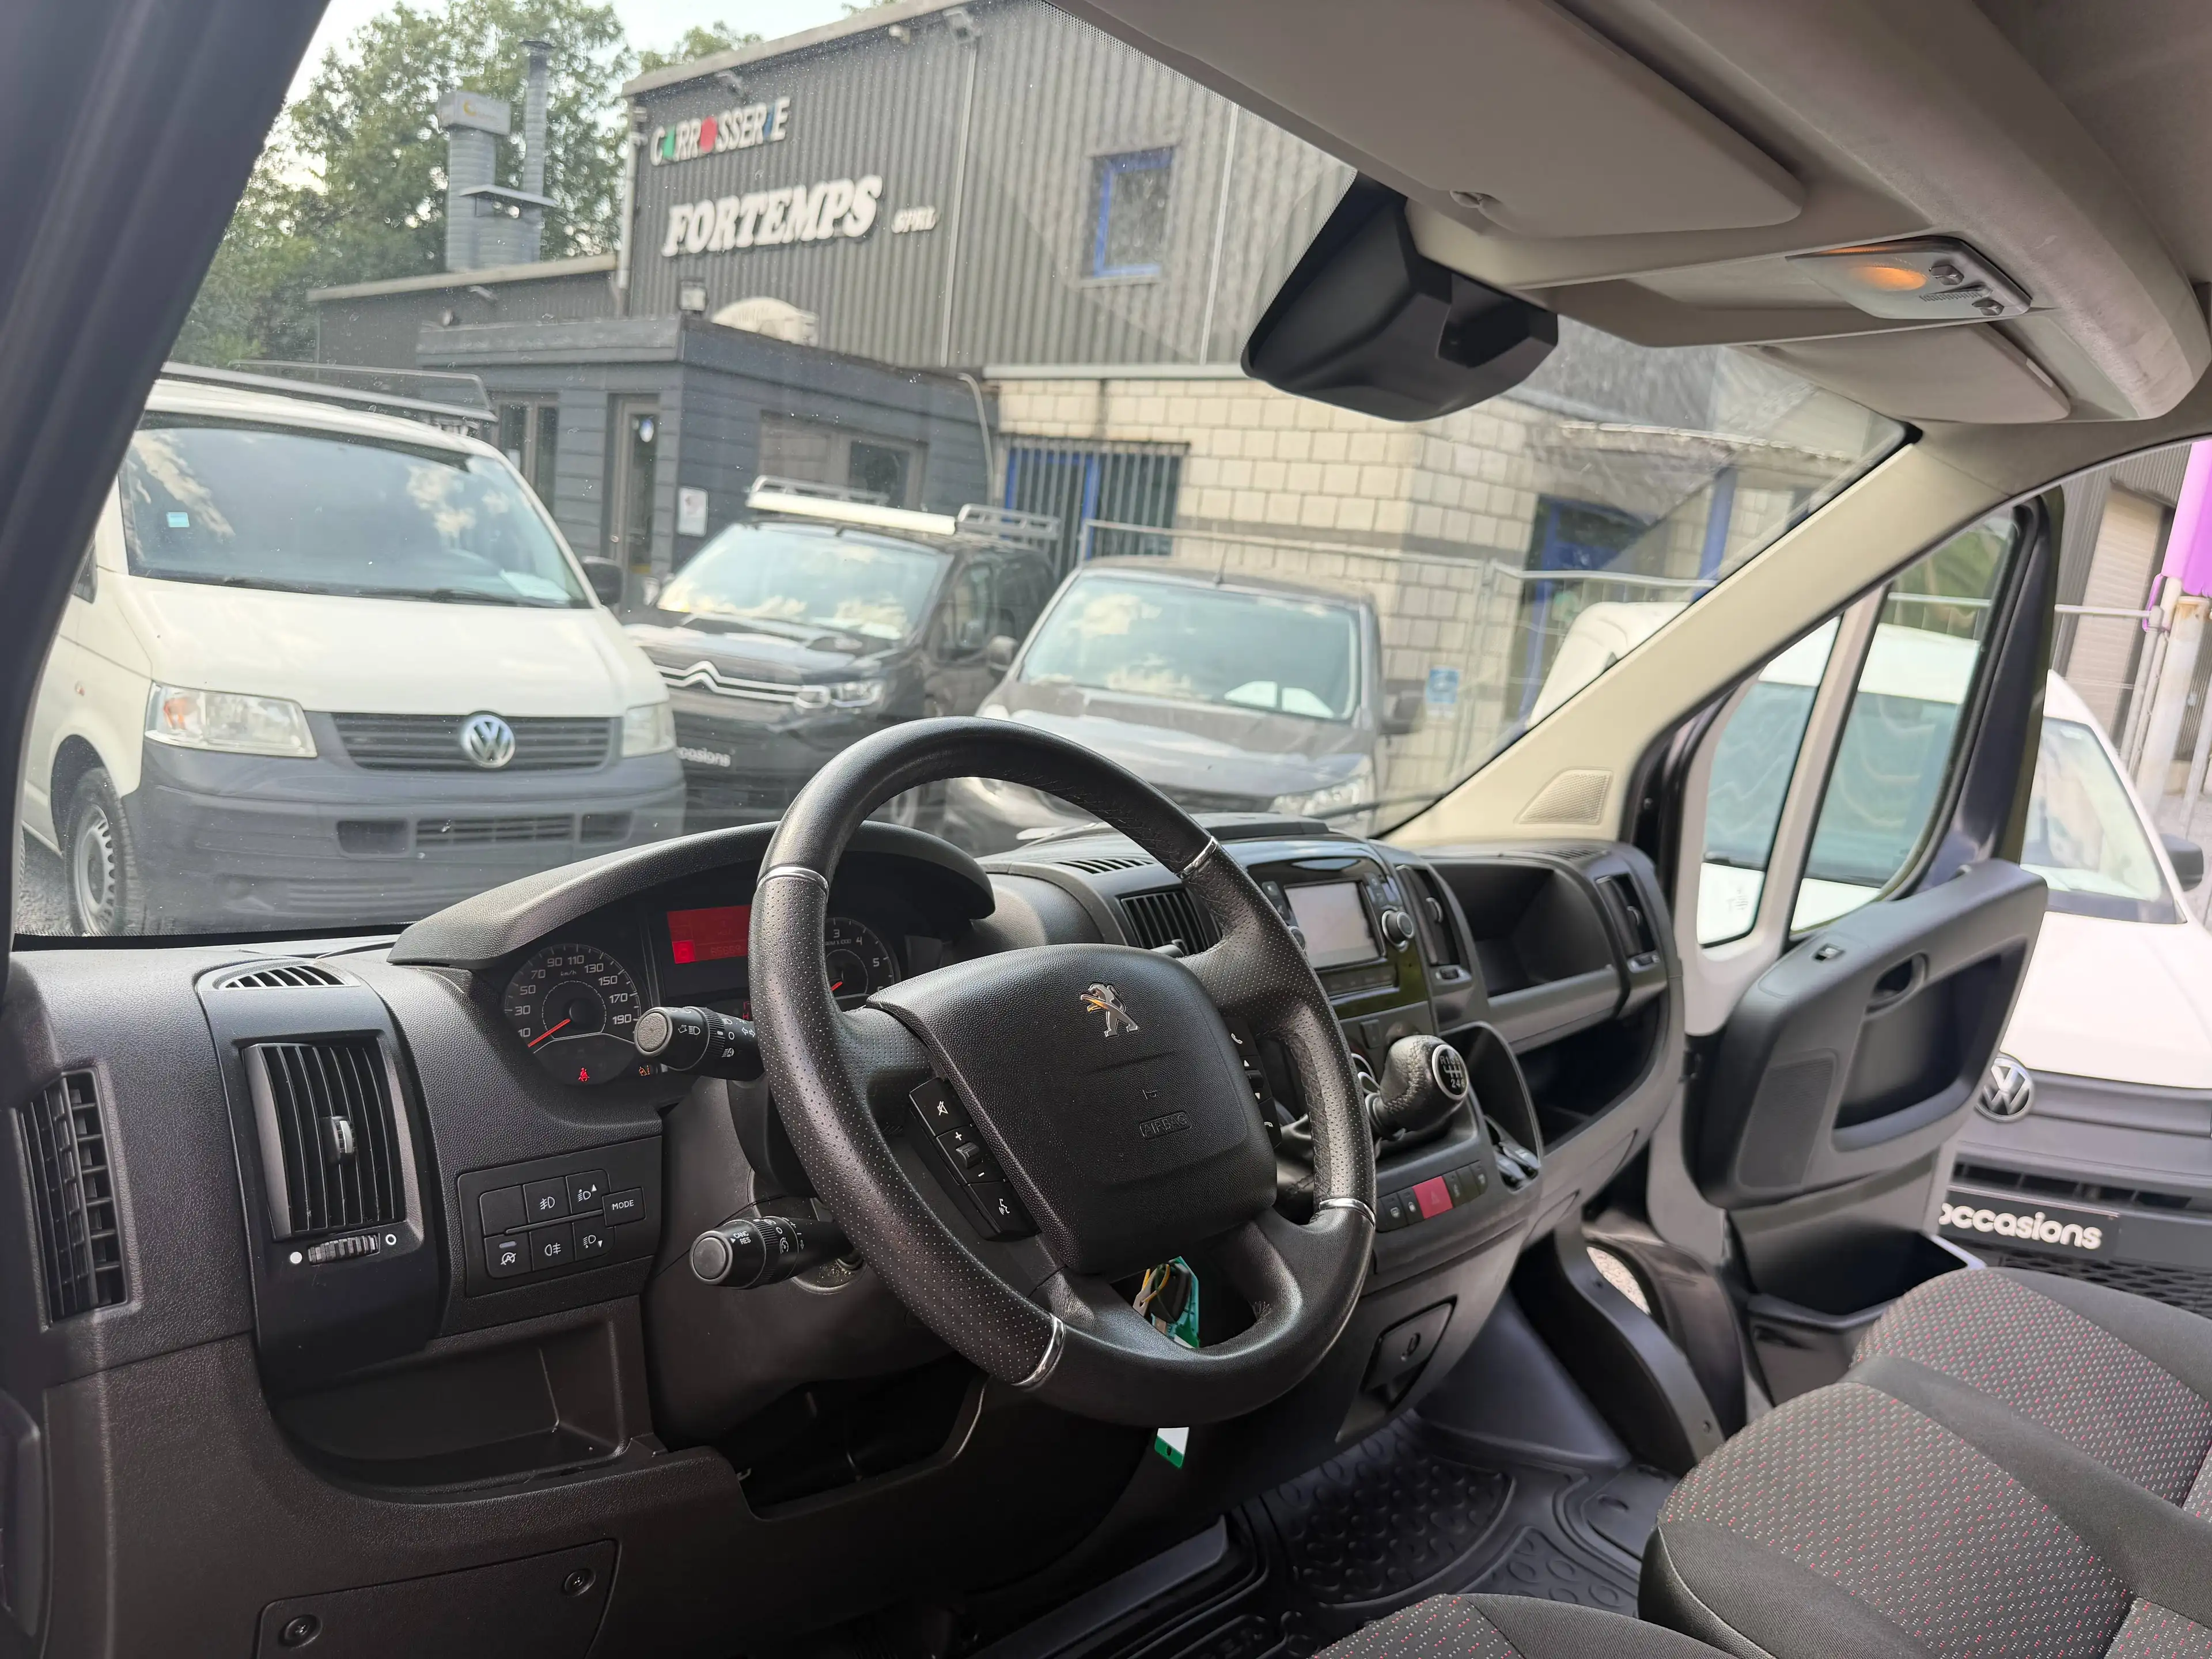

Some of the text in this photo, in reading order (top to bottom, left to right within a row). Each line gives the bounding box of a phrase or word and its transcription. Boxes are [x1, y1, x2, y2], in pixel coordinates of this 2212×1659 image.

[650, 96, 790, 166] CARROSSERIE
[662, 175, 882, 257] FORTEMPS
[833, 929, 840, 938] 3
[856, 935, 863, 945] 4
[547, 957, 563, 967] 90
[567, 955, 585, 965] 110
[873, 957, 880, 967] 5
[584, 963, 604, 974] 130
[531, 969, 546, 979] 70
[599, 975, 618, 986] 150
[520, 984, 536, 995] 50
[609, 993, 628, 1003] 170
[514, 1005, 531, 1016] 30
[612, 1014, 632, 1025] 190
[518, 1028, 531, 1037] 10
[612, 1199, 634, 1210] MODE
[733, 1230, 749, 1238] CANC
